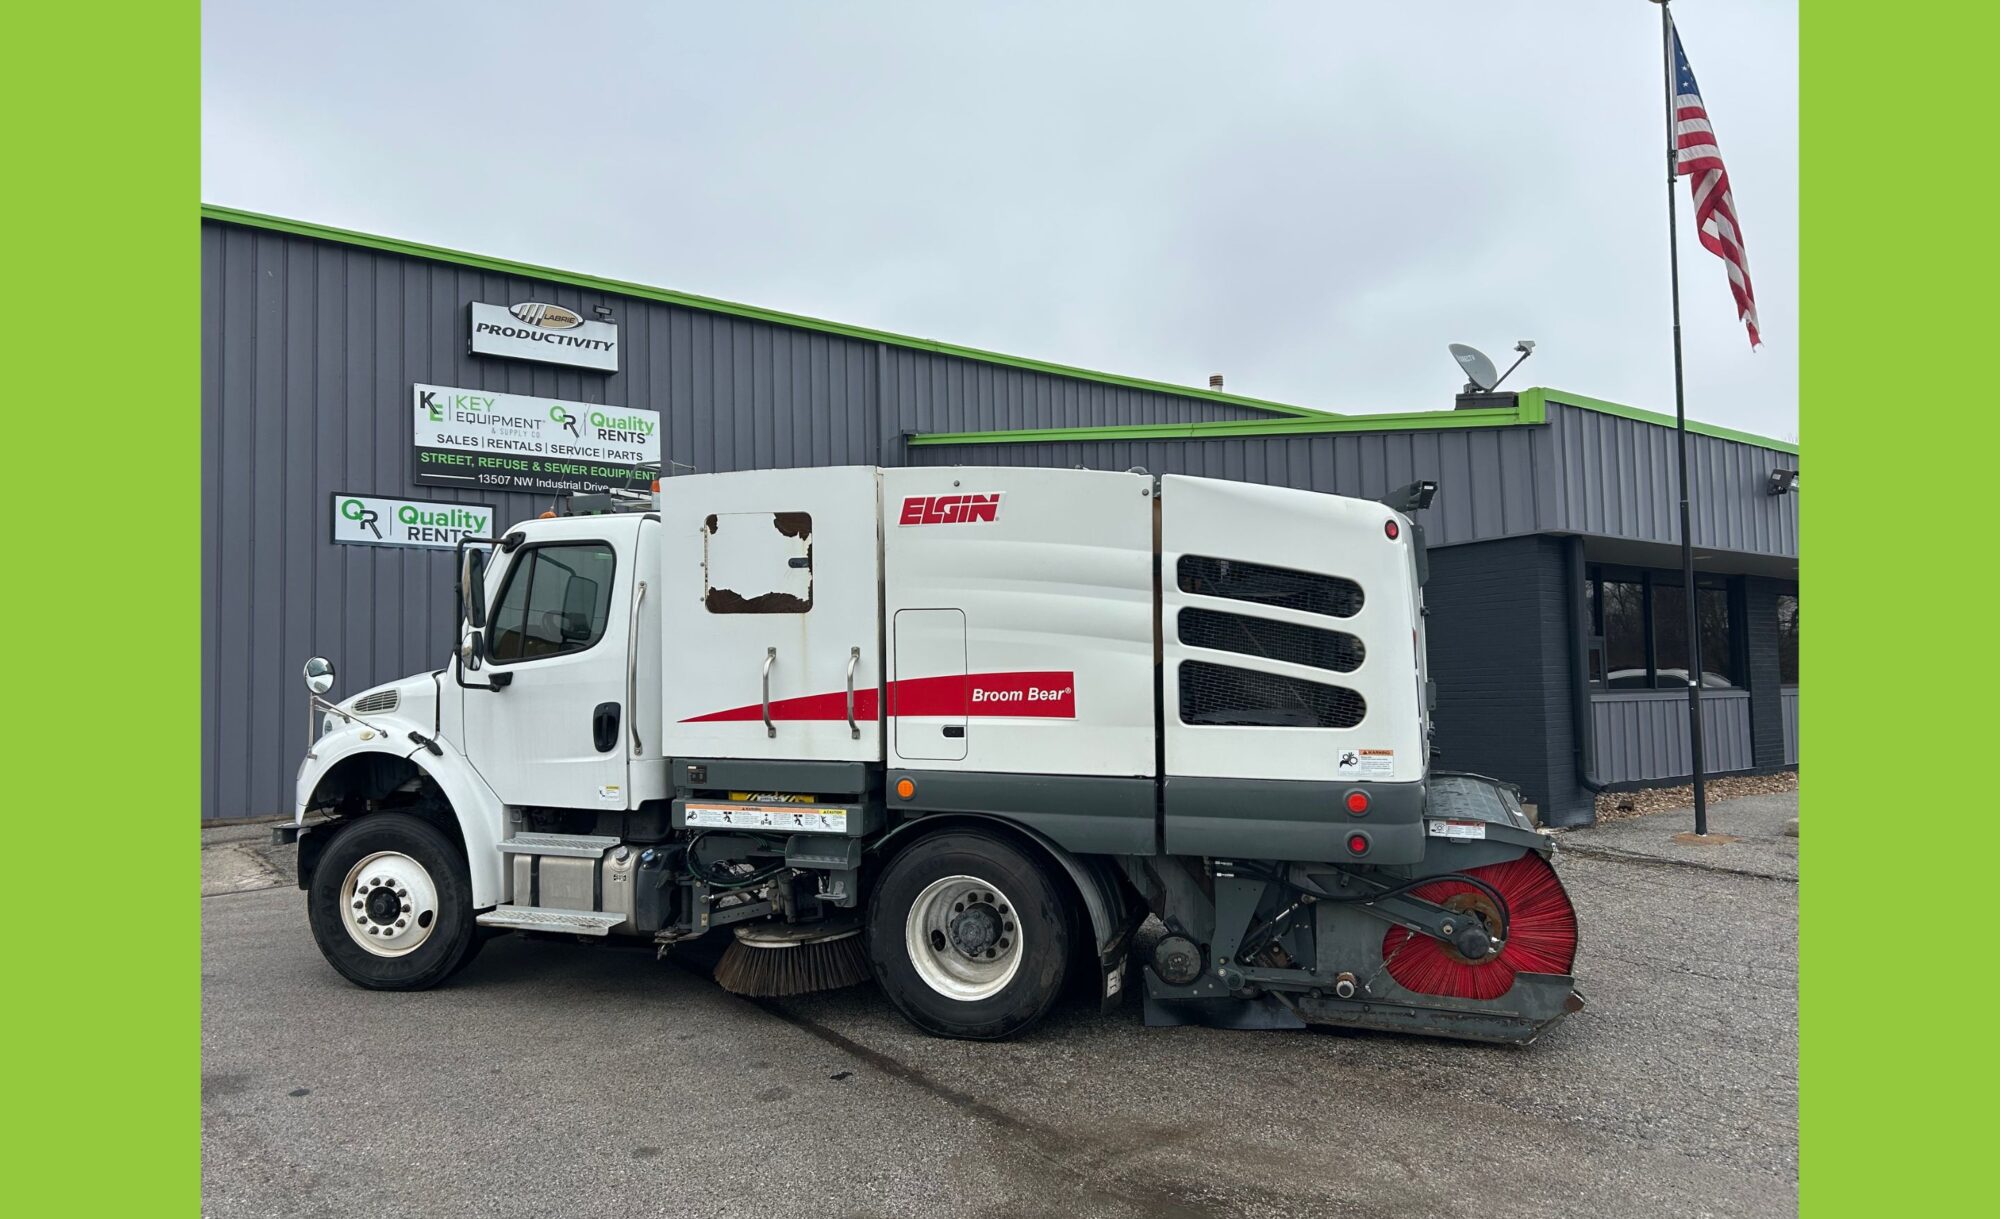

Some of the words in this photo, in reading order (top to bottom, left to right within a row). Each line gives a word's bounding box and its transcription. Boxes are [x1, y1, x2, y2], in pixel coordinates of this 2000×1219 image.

[544, 313, 576, 324] LABRIE
[476, 322, 615, 352] PRODUCTIVITY
[456, 395, 495, 412] KEY
[456, 411, 542, 430] EQUIPMENT
[590, 412, 654, 435] Quality
[500, 428, 528, 437] SUPPLY
[597, 428, 646, 444] RENTS
[437, 434, 479, 447] SALES
[487, 438, 543, 452] RENTALS
[550, 444, 600, 457] SERVICE
[607, 449, 643, 461] PARTS
[421, 452, 475, 468] STREET,
[478, 457, 529, 471] REFUSE
[532, 461, 541, 472] &
[544, 462, 588, 475] SEWER
[478, 474, 510, 485] 13507
[514, 477, 533, 487] NW
[536, 478, 581, 490] Industrial
[584, 482, 609, 491] Drive
[899, 494, 1000, 524] ELGIN
[398, 505, 487, 533] Quality
[972, 688, 1023, 702] Broom
